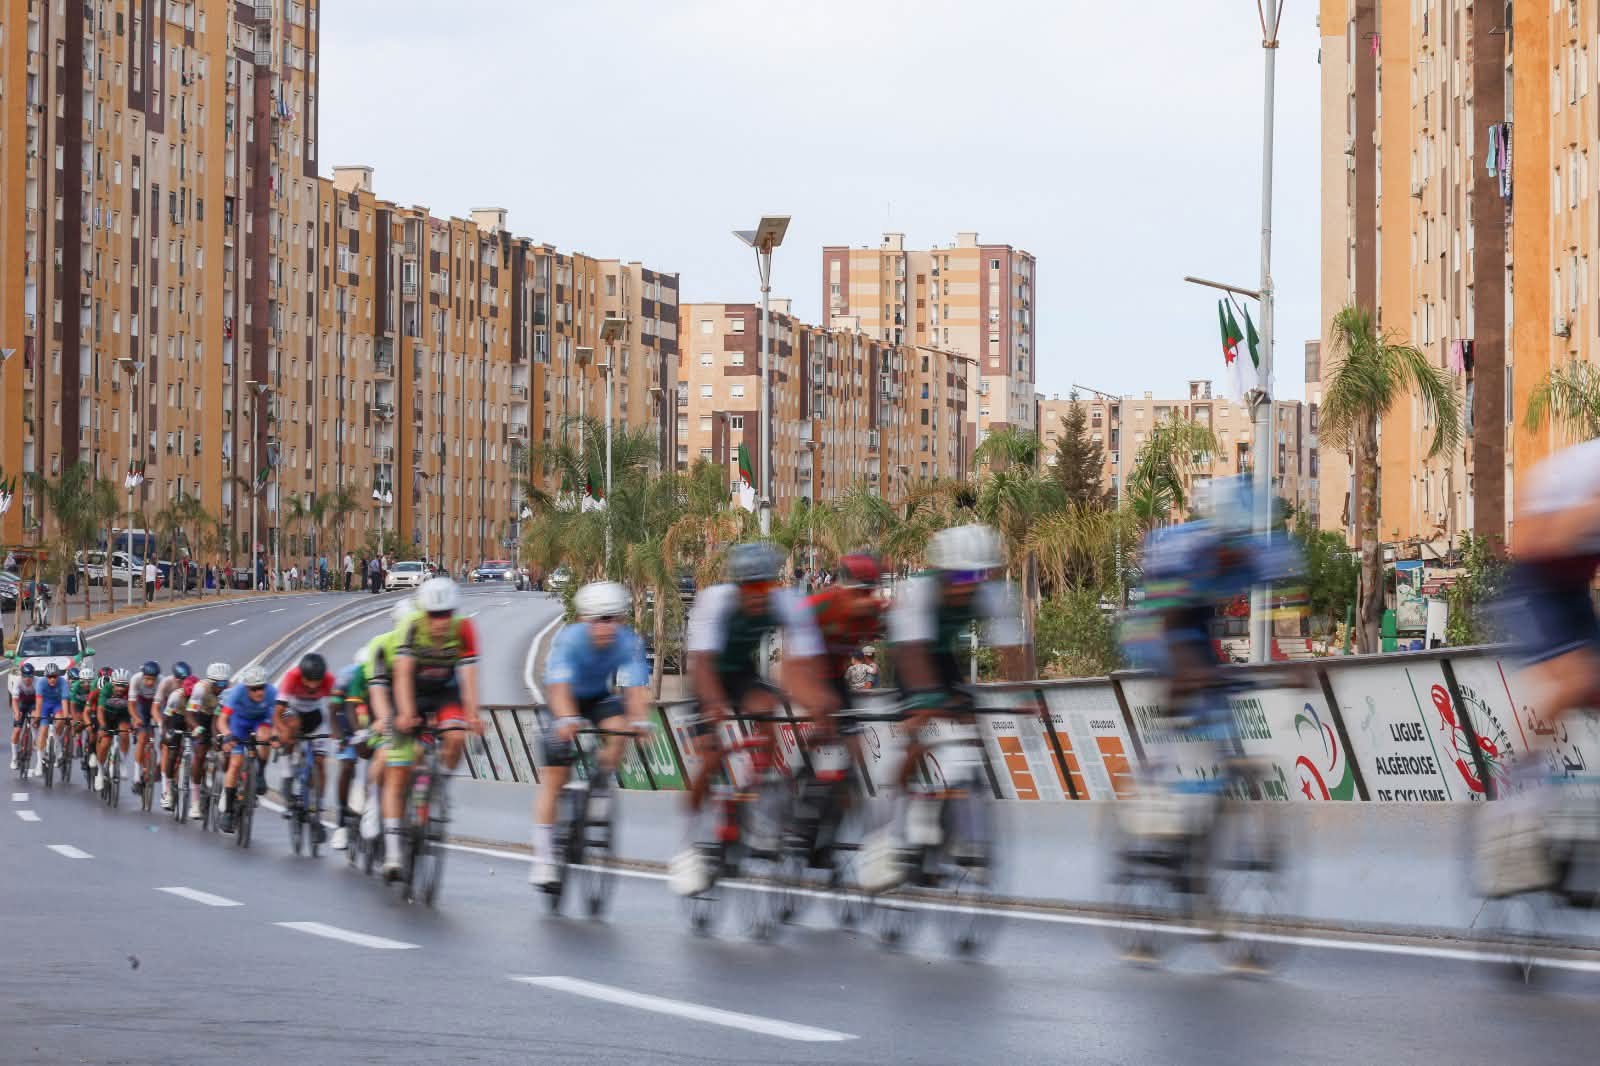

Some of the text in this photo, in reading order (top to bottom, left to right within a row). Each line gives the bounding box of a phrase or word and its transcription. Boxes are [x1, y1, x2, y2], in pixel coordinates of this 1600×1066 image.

[1389, 722, 1425, 742] LIGUE
[1375, 752, 1437, 775] ALGÉROISE
[1377, 789, 1393, 801] DE
